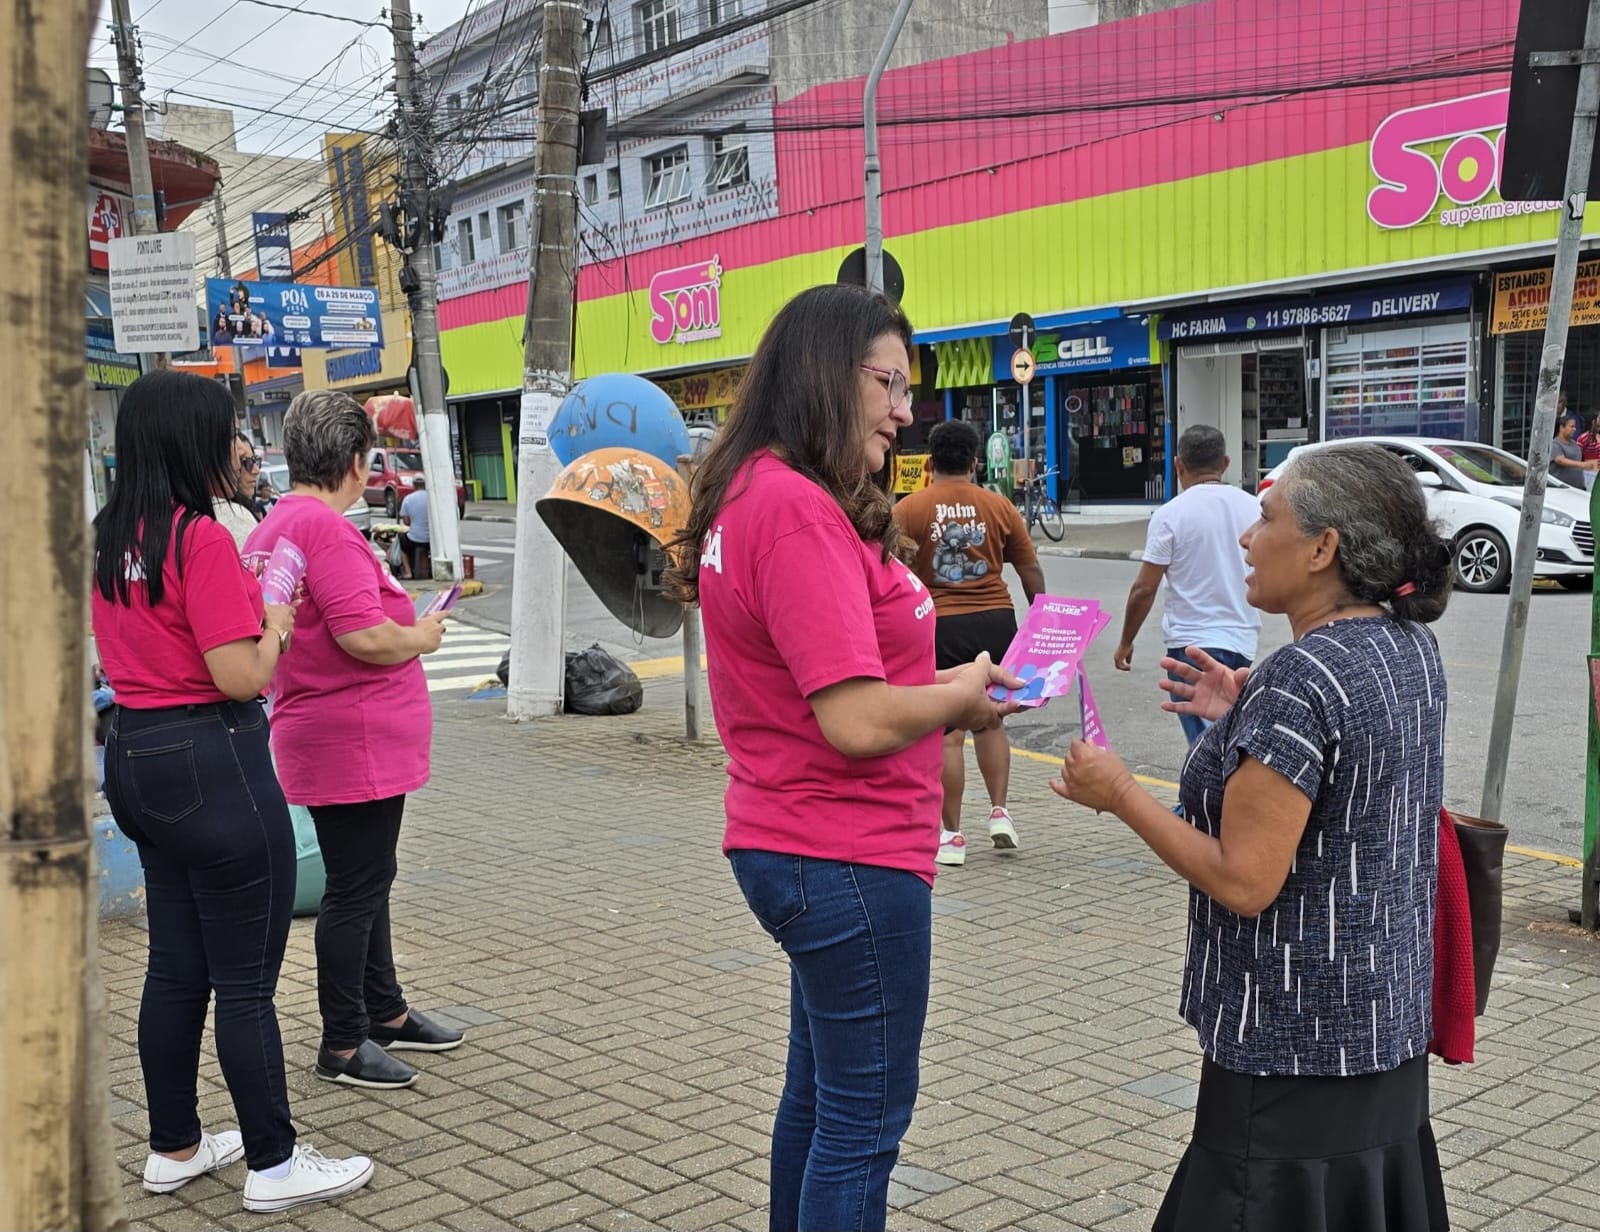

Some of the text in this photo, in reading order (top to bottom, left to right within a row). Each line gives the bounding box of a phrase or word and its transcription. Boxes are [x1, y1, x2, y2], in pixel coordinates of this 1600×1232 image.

[1367, 87, 1511, 229] So
[1440, 200, 1565, 227] supermerca
[1498, 271, 1546, 291] ESTAMOS
[280, 288, 310, 309] POÁ
[326, 290, 331, 298] A
[340, 291, 349, 299] DE
[350, 292, 373, 302] MARÇO
[649, 254, 722, 344] Soni
[1371, 292, 1441, 318] DELIVERY
[1171, 304, 1352, 339] HC FARMA 11 97886-5627
[935, 502, 977, 523] Palm
[1041, 627, 1077, 636] CONHEÇA
[1028, 646, 1051, 656] APOIO
[1062, 647, 1078, 655] POÁ
